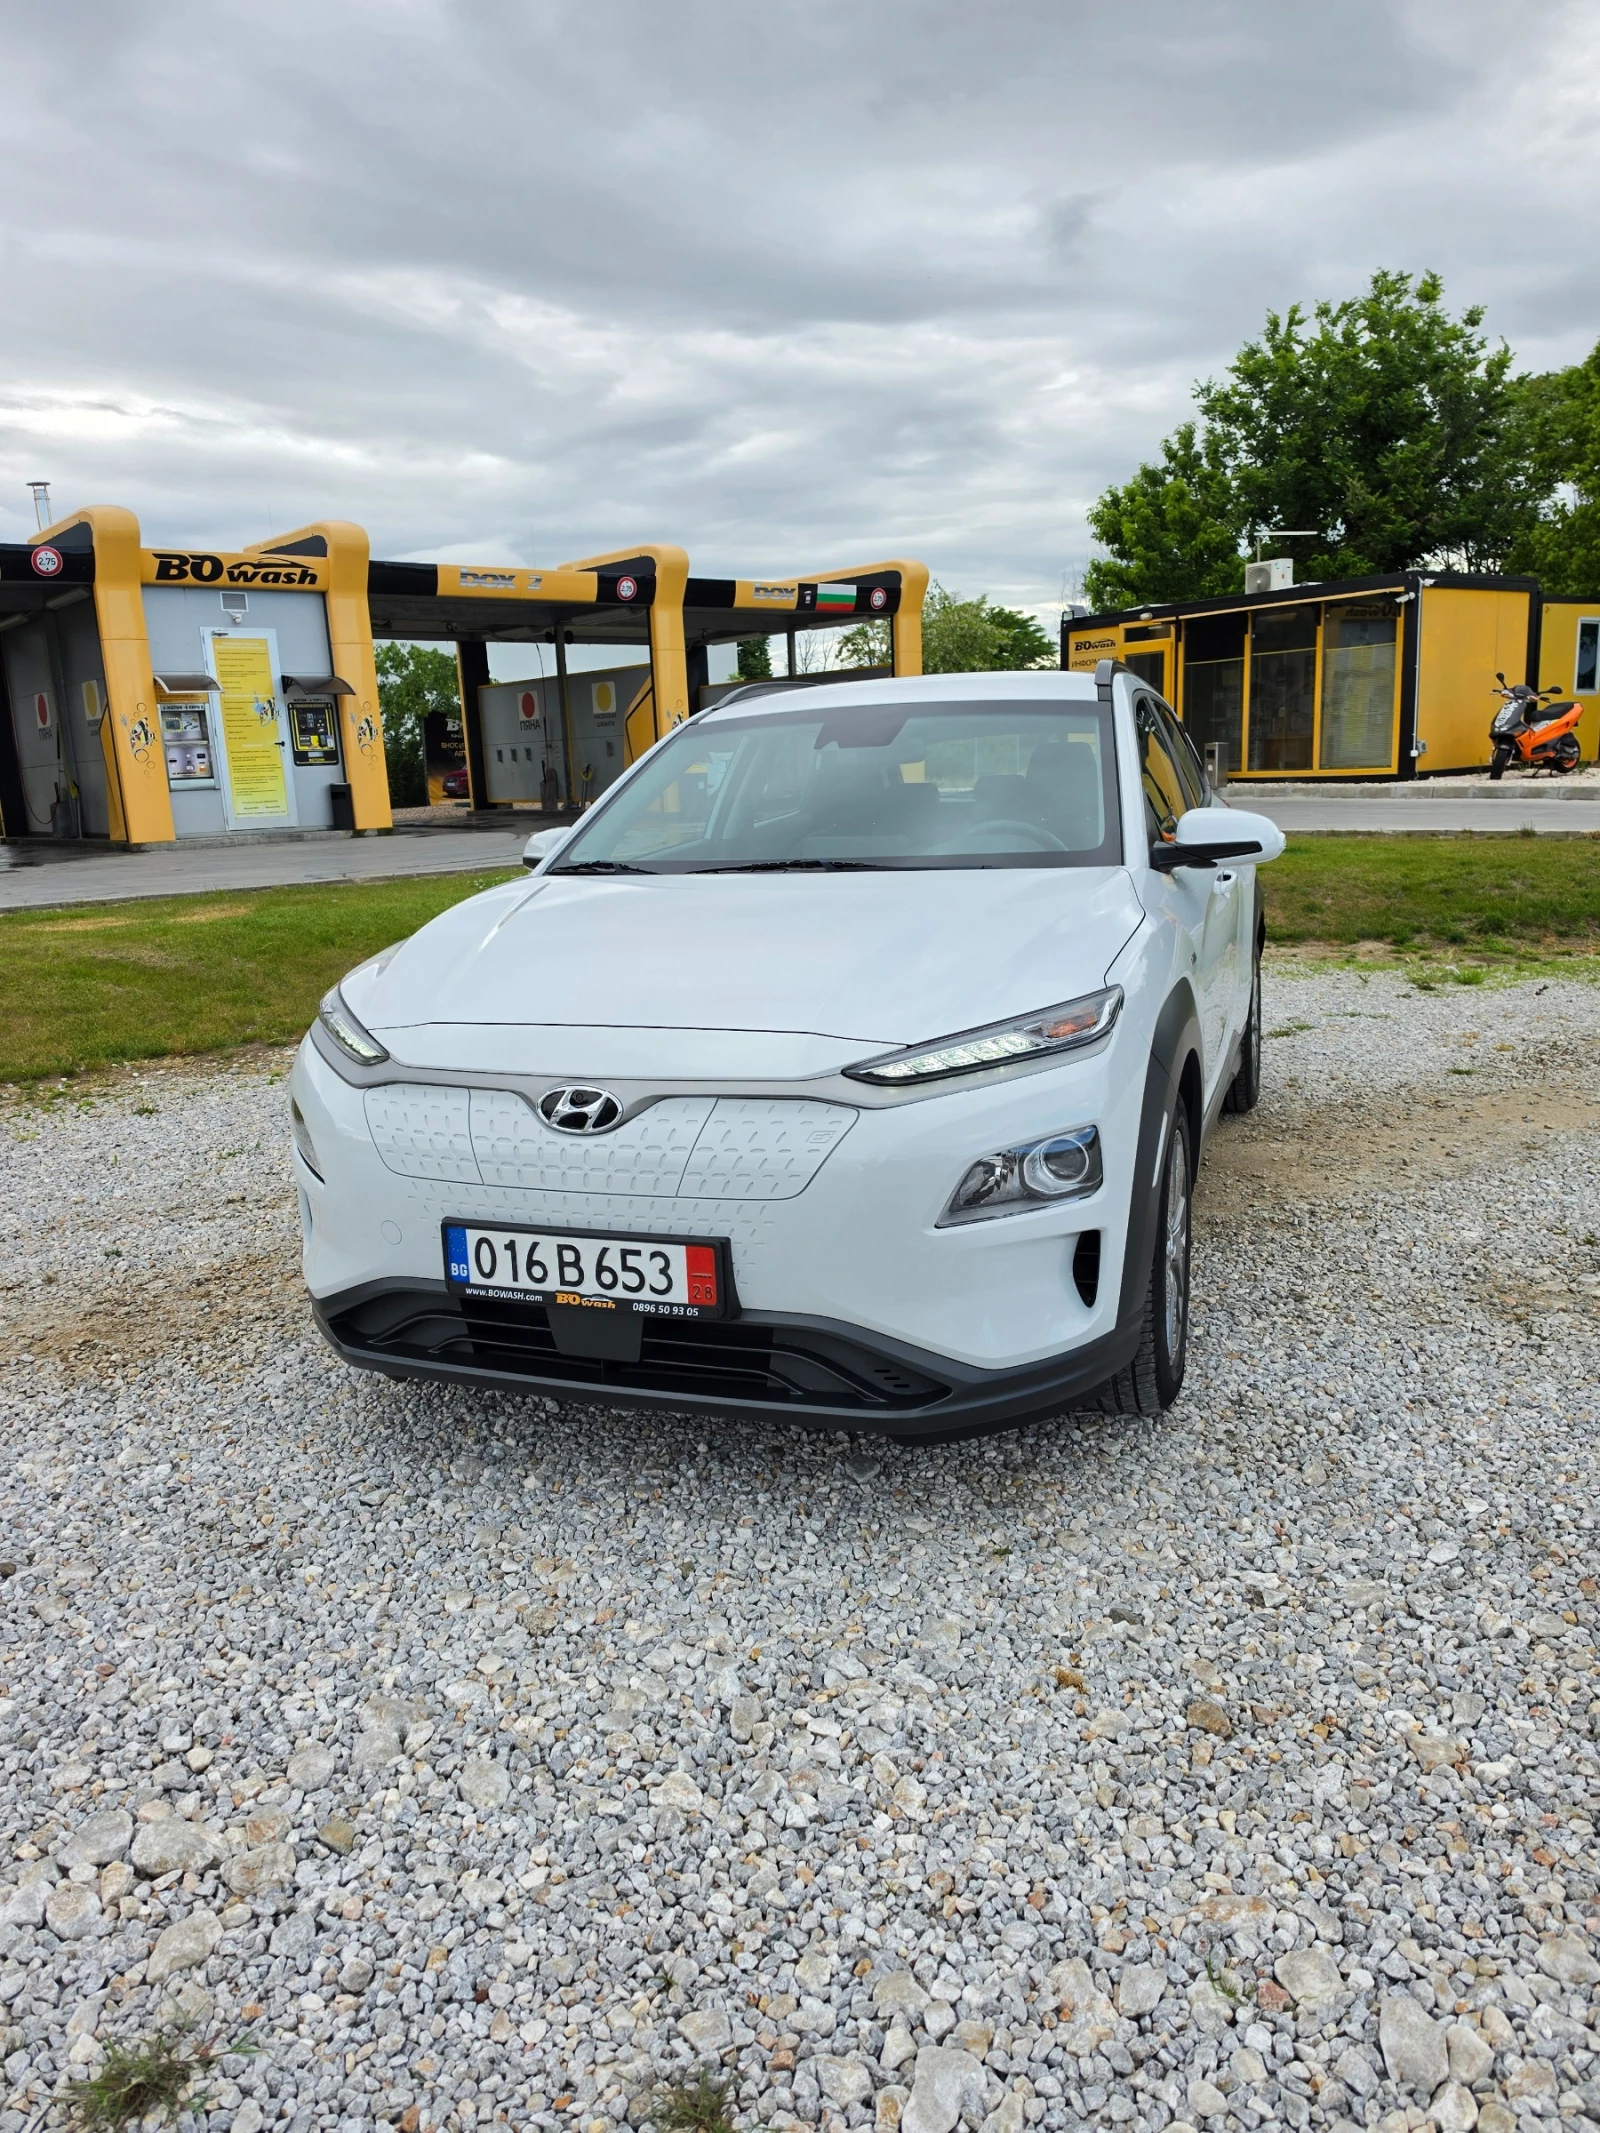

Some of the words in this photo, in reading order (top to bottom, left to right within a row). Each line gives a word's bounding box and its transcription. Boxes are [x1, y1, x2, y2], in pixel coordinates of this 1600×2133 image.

[38, 557, 56, 566] 2.75
[459, 566, 517, 589] box
[527, 575, 542, 590] 2
[620, 584, 633, 593] 2.75
[753, 582, 796, 600] box
[804, 590, 812, 604] 1
[520, 719, 541, 732] ПЯНА
[451, 1262, 468, 1277] BG
[465, 1287, 543, 1302] www.BOWASH.com
[692, 1283, 713, 1300] 28
[632, 1302, 656, 1313] 0896
[658, 1305, 670, 1314] 50
[672, 1306, 684, 1315] 93
[686, 1308, 699, 1316] 05
